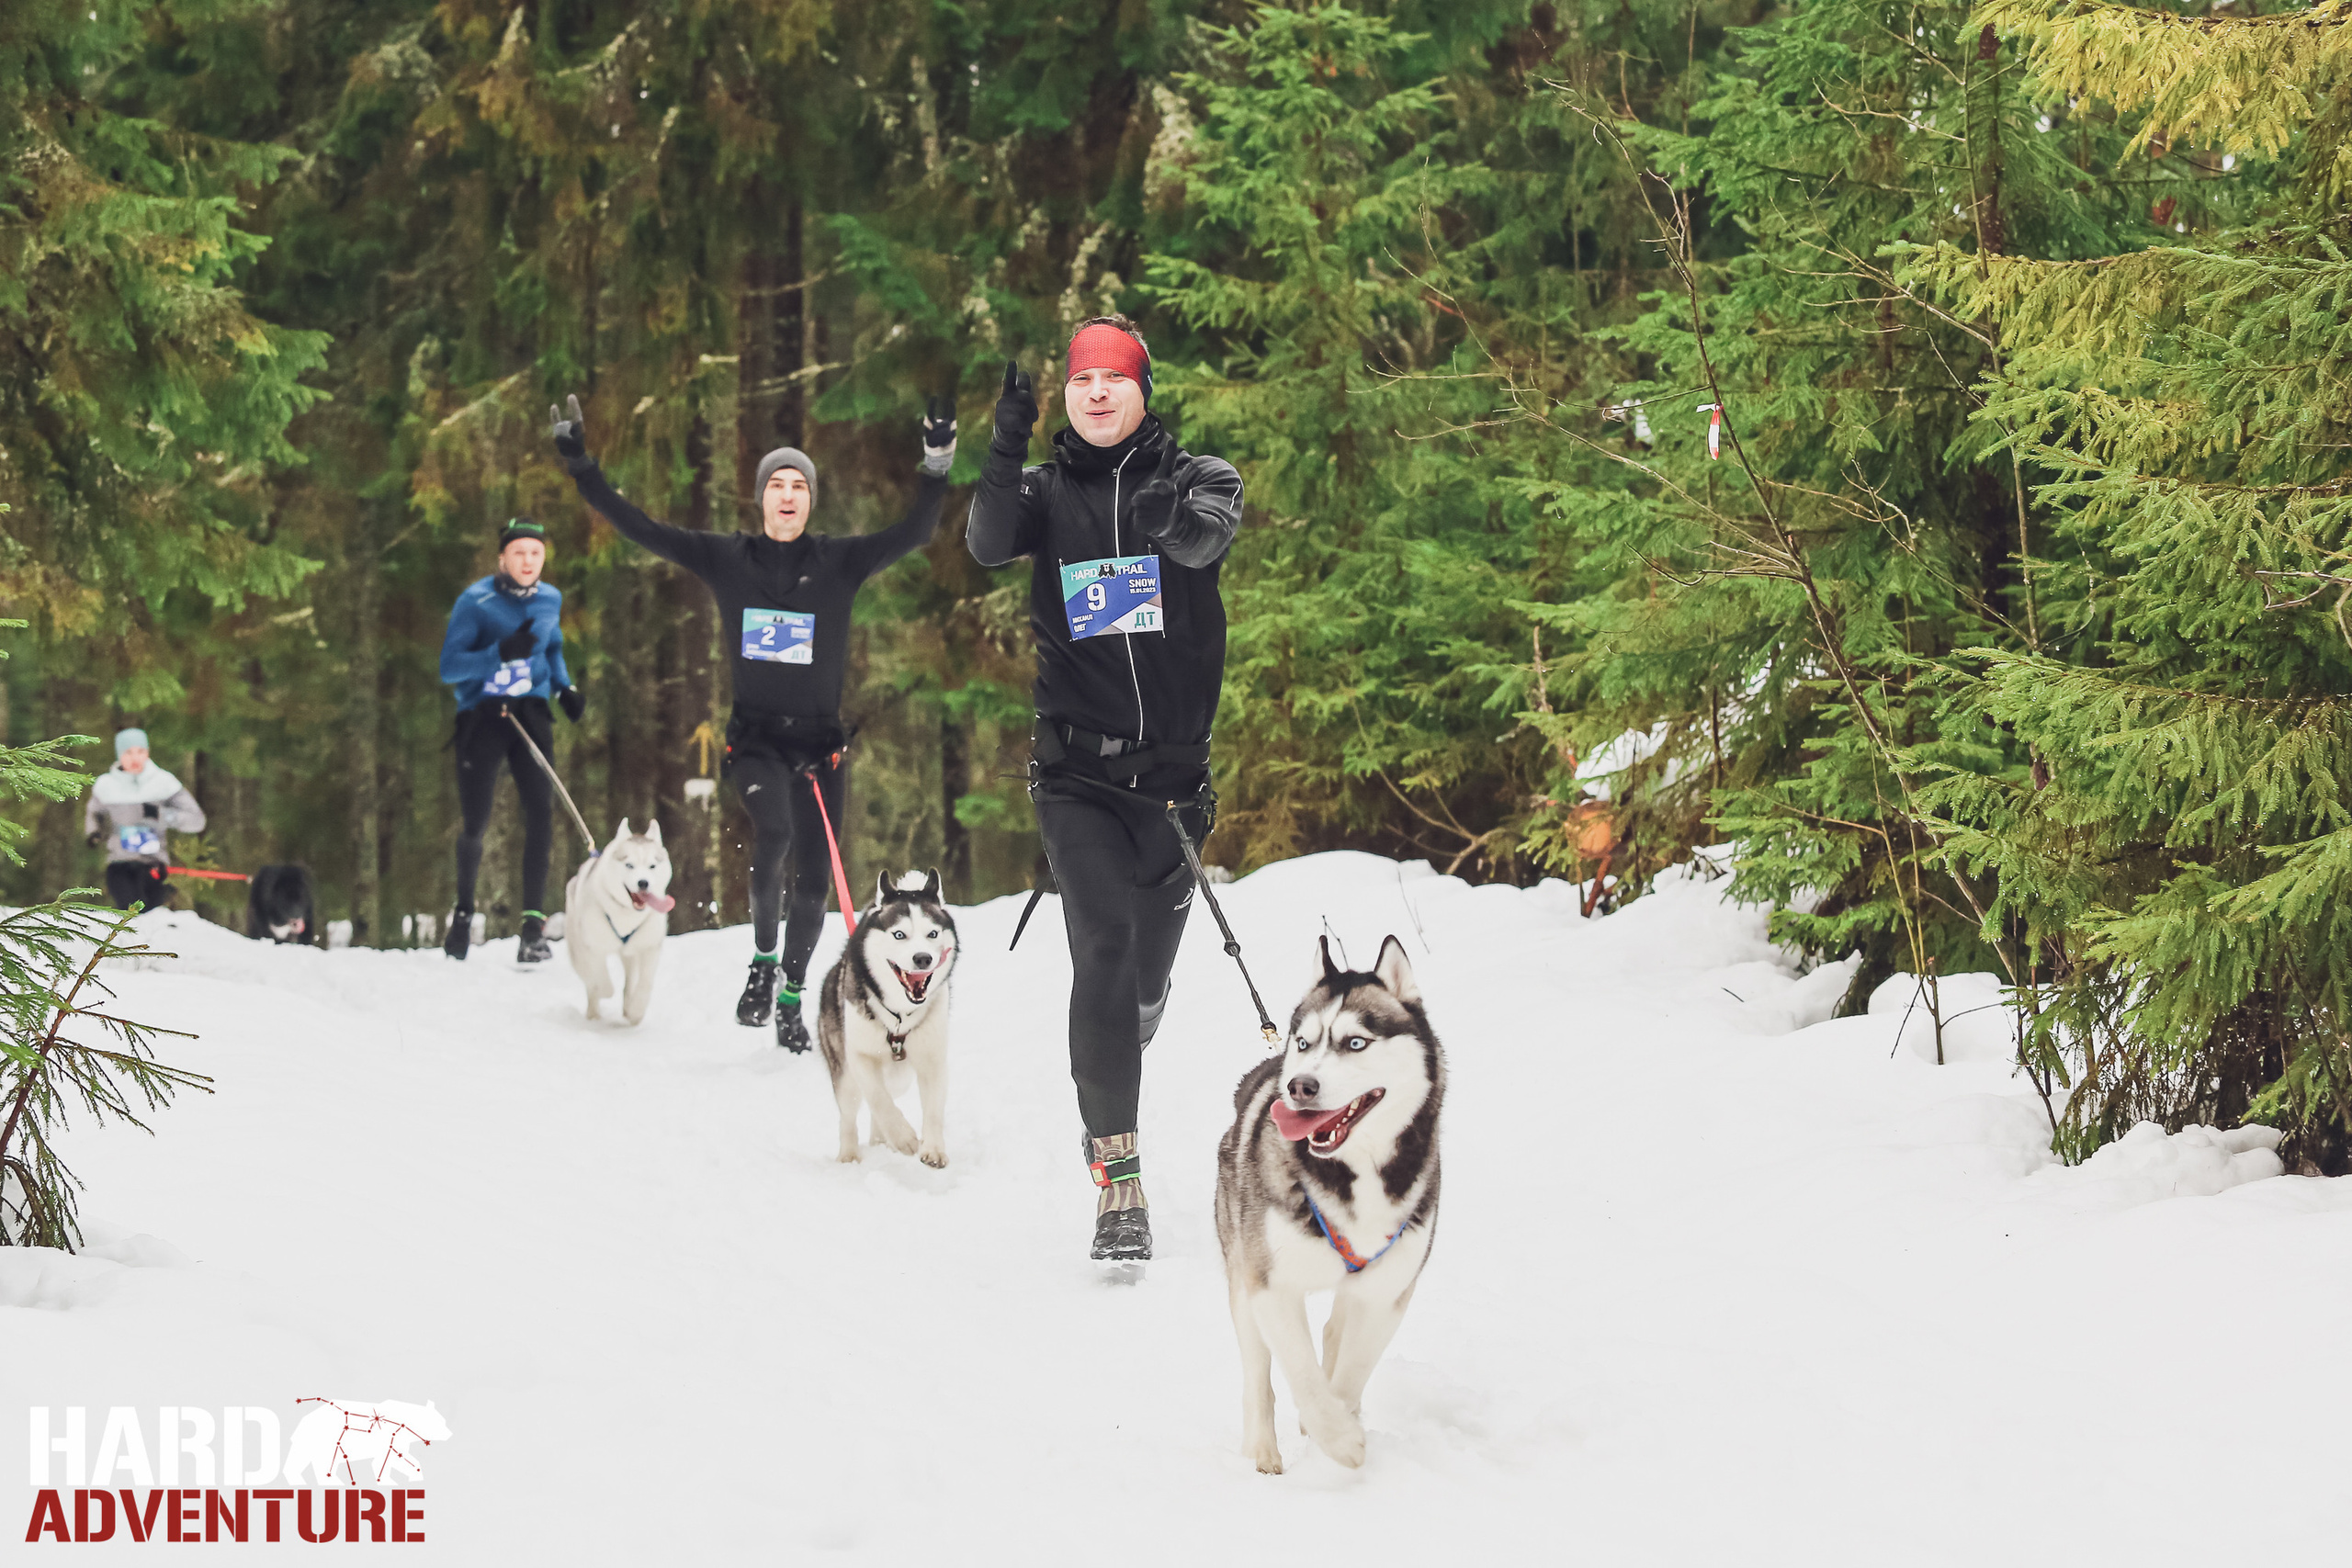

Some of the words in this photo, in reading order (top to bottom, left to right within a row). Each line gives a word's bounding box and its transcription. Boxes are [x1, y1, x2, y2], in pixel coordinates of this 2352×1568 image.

[1070, 568, 1098, 581] HARD
[1116, 564, 1148, 575] TRAIL
[1128, 578, 1156, 588] SNOW
[1087, 582, 1106, 611] 9
[1135, 612, 1155, 628] ДТ
[761, 626, 776, 646] 2
